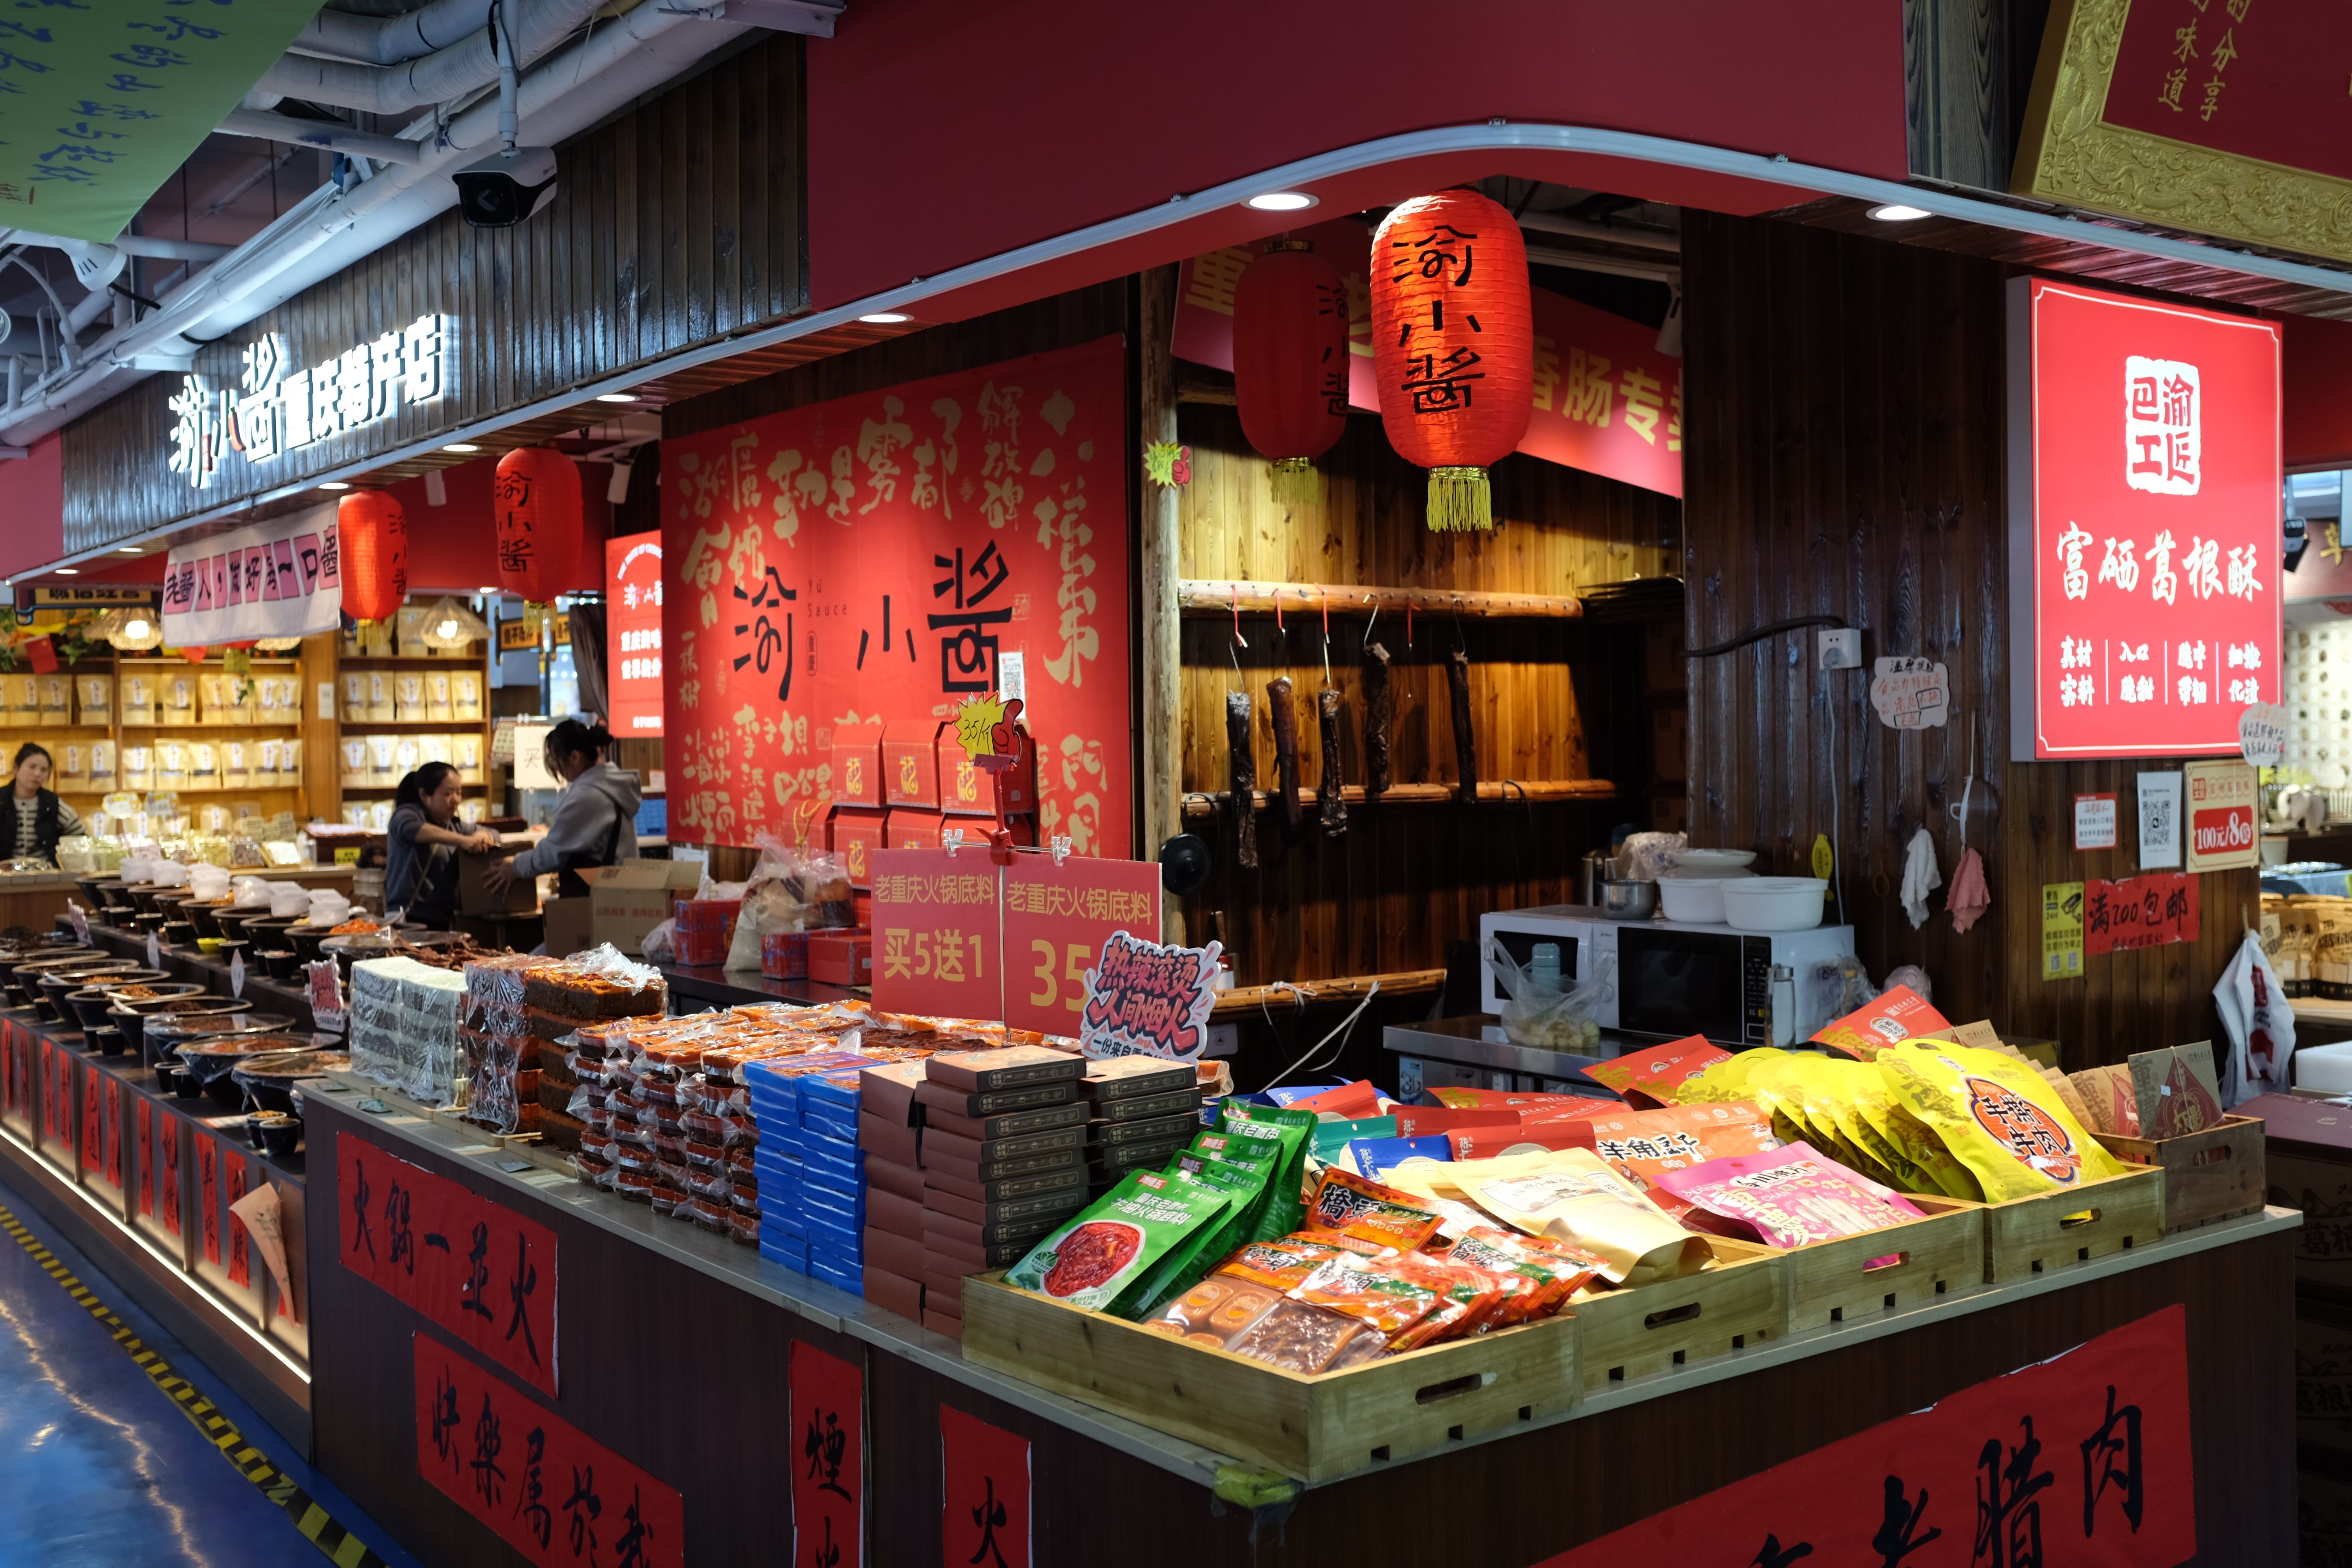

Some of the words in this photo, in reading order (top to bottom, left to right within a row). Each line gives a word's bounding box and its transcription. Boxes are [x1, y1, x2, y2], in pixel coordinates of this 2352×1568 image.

[1392, 225, 1485, 414] 渝小酱
[2057, 521, 2263, 605] 富硒葛根酥
[808, 603, 848, 618] Sauce
[2119, 642, 2149, 662] 入口
[874, 874, 995, 906] 老重庆火锅底料
[1007, 881, 1153, 925] 老重庆火锅底料
[884, 928, 982, 982] 买5送1
[1030, 940, 1091, 1012] 35
[1096, 936, 1201, 1003] 热辣滚烫
[1086, 988, 1199, 1055] 人间烟火
[1111, 1198, 1193, 1225] 牛油火锅底料
